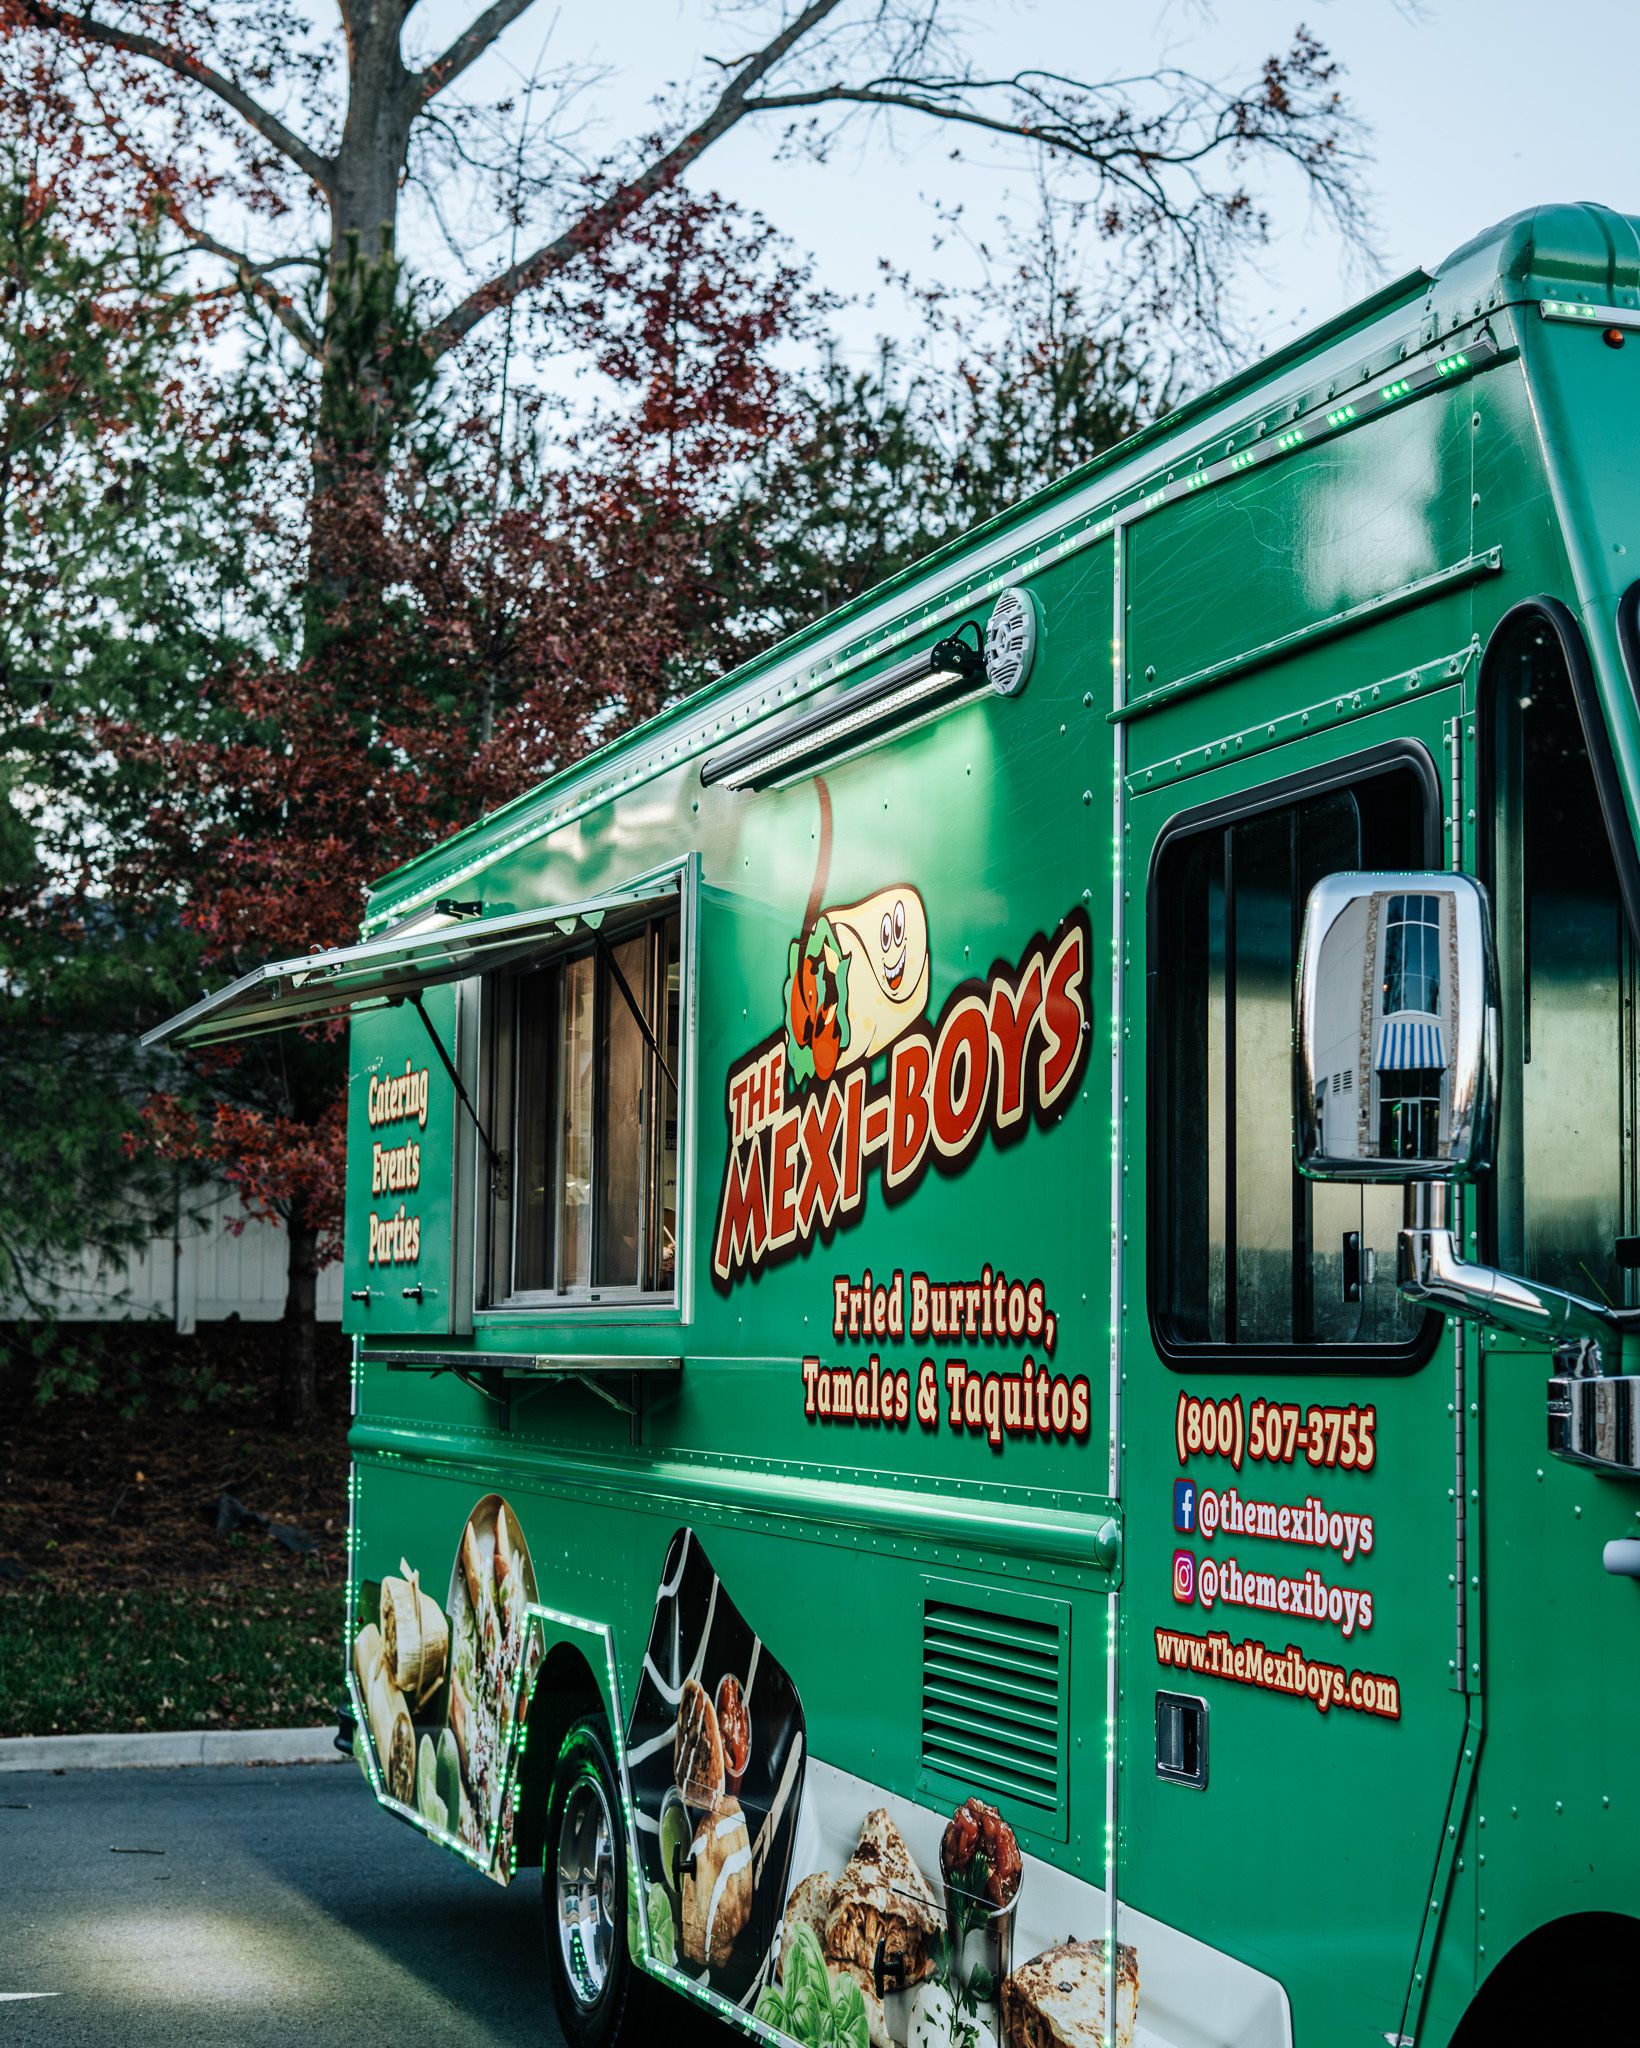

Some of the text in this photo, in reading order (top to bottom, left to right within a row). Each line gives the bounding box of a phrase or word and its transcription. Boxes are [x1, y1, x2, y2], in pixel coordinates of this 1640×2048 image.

[369, 1058, 428, 1126] Catering
[714, 925, 1085, 1280] MEXI-BOYS
[730, 1041, 785, 1147] THE
[372, 1137, 419, 1193] Events
[369, 1203, 419, 1263] Parties
[834, 1264, 1054, 1349] Fried Burritos,
[803, 1356, 1089, 1444] Tamales & Taquitos
[1177, 1393, 1376, 1470] (800) 507-3755
[1199, 1488, 1373, 1561] @themexiboys
[1199, 1557, 1373, 1637] @themexiboys
[1154, 1627, 1400, 1720] www.TheMexiboys.com
